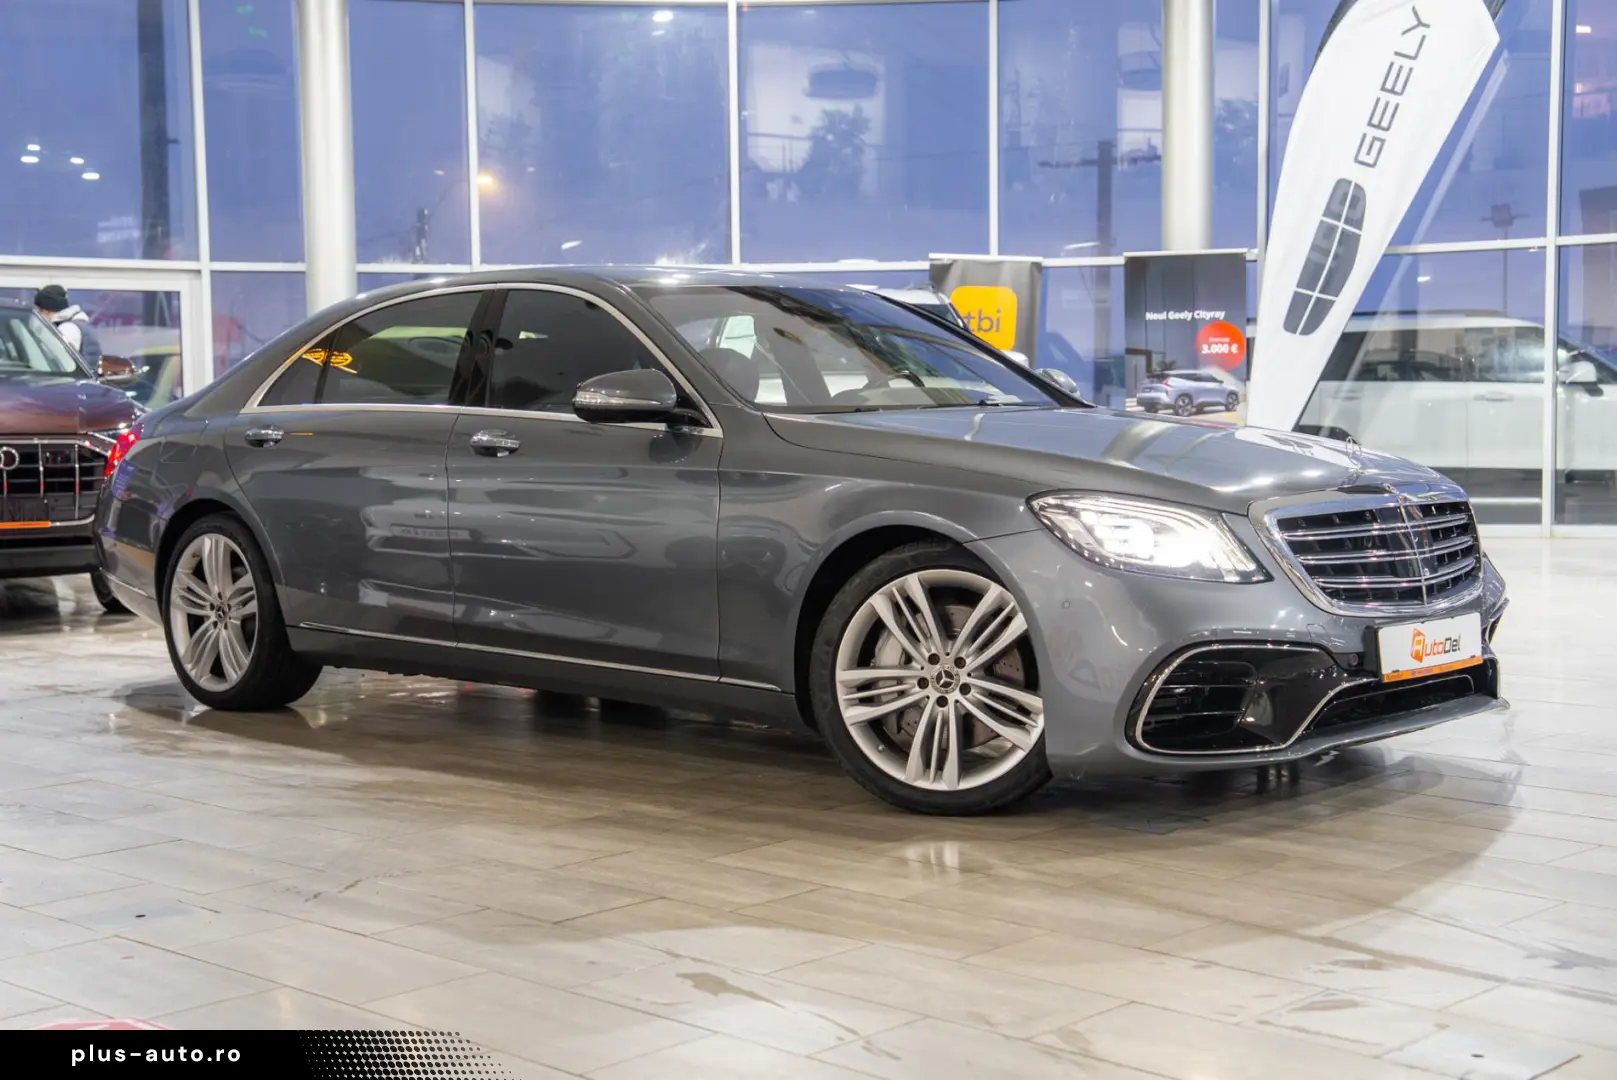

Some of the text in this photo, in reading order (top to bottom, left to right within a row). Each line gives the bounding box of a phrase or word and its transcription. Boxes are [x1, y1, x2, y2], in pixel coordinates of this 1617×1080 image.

[1354, 5, 1431, 168] GEELY
[963, 308, 1002, 333] tbi
[1168, 310, 1193, 321] Geely
[1194, 310, 1225, 320] Cityray
[1202, 344, 1238, 354] 3.000 €
[1410, 628, 1461, 663] AutoDel
